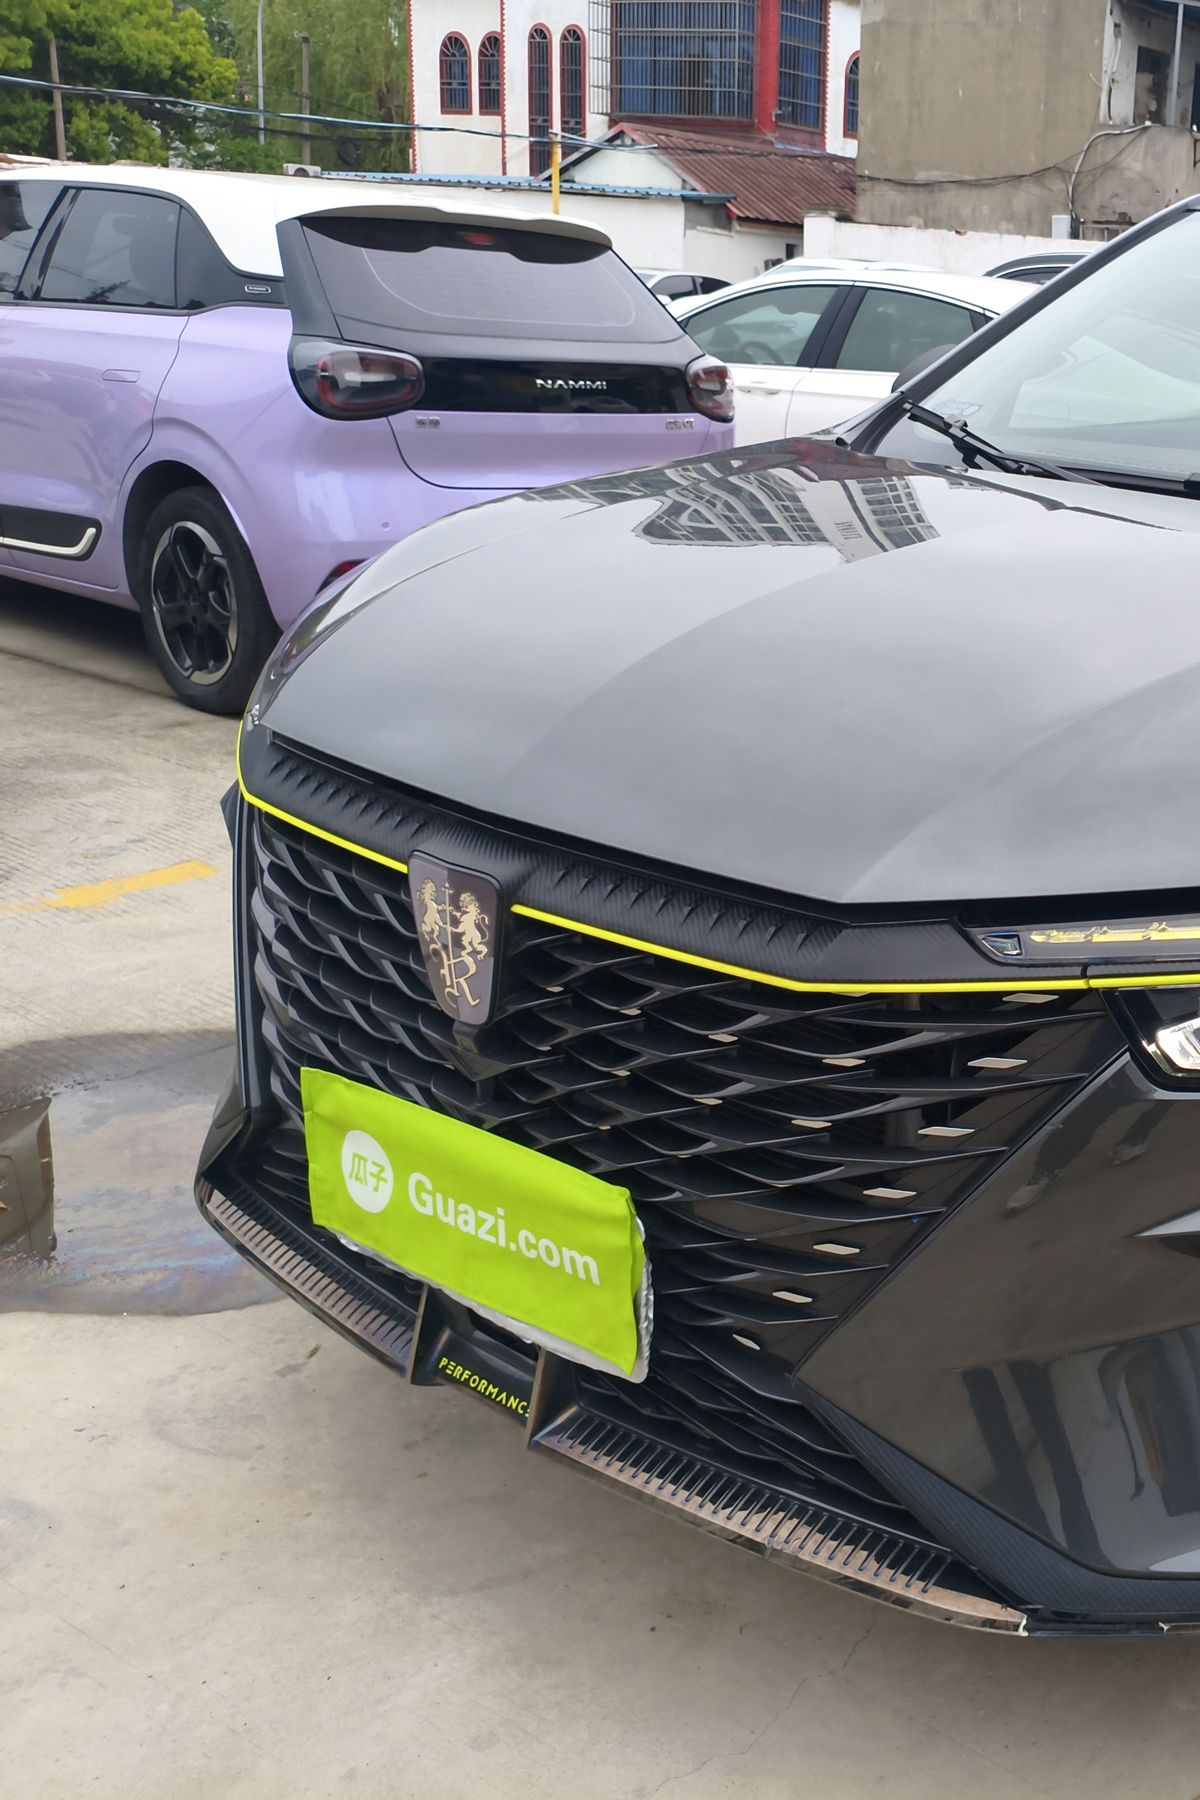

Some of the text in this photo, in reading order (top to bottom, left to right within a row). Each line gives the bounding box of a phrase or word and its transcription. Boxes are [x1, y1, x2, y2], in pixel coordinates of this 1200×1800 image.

[535, 378, 607, 390] NAMMI
[348, 1152, 389, 1194] 瓜子
[408, 1172, 600, 1287] Guazi.com
